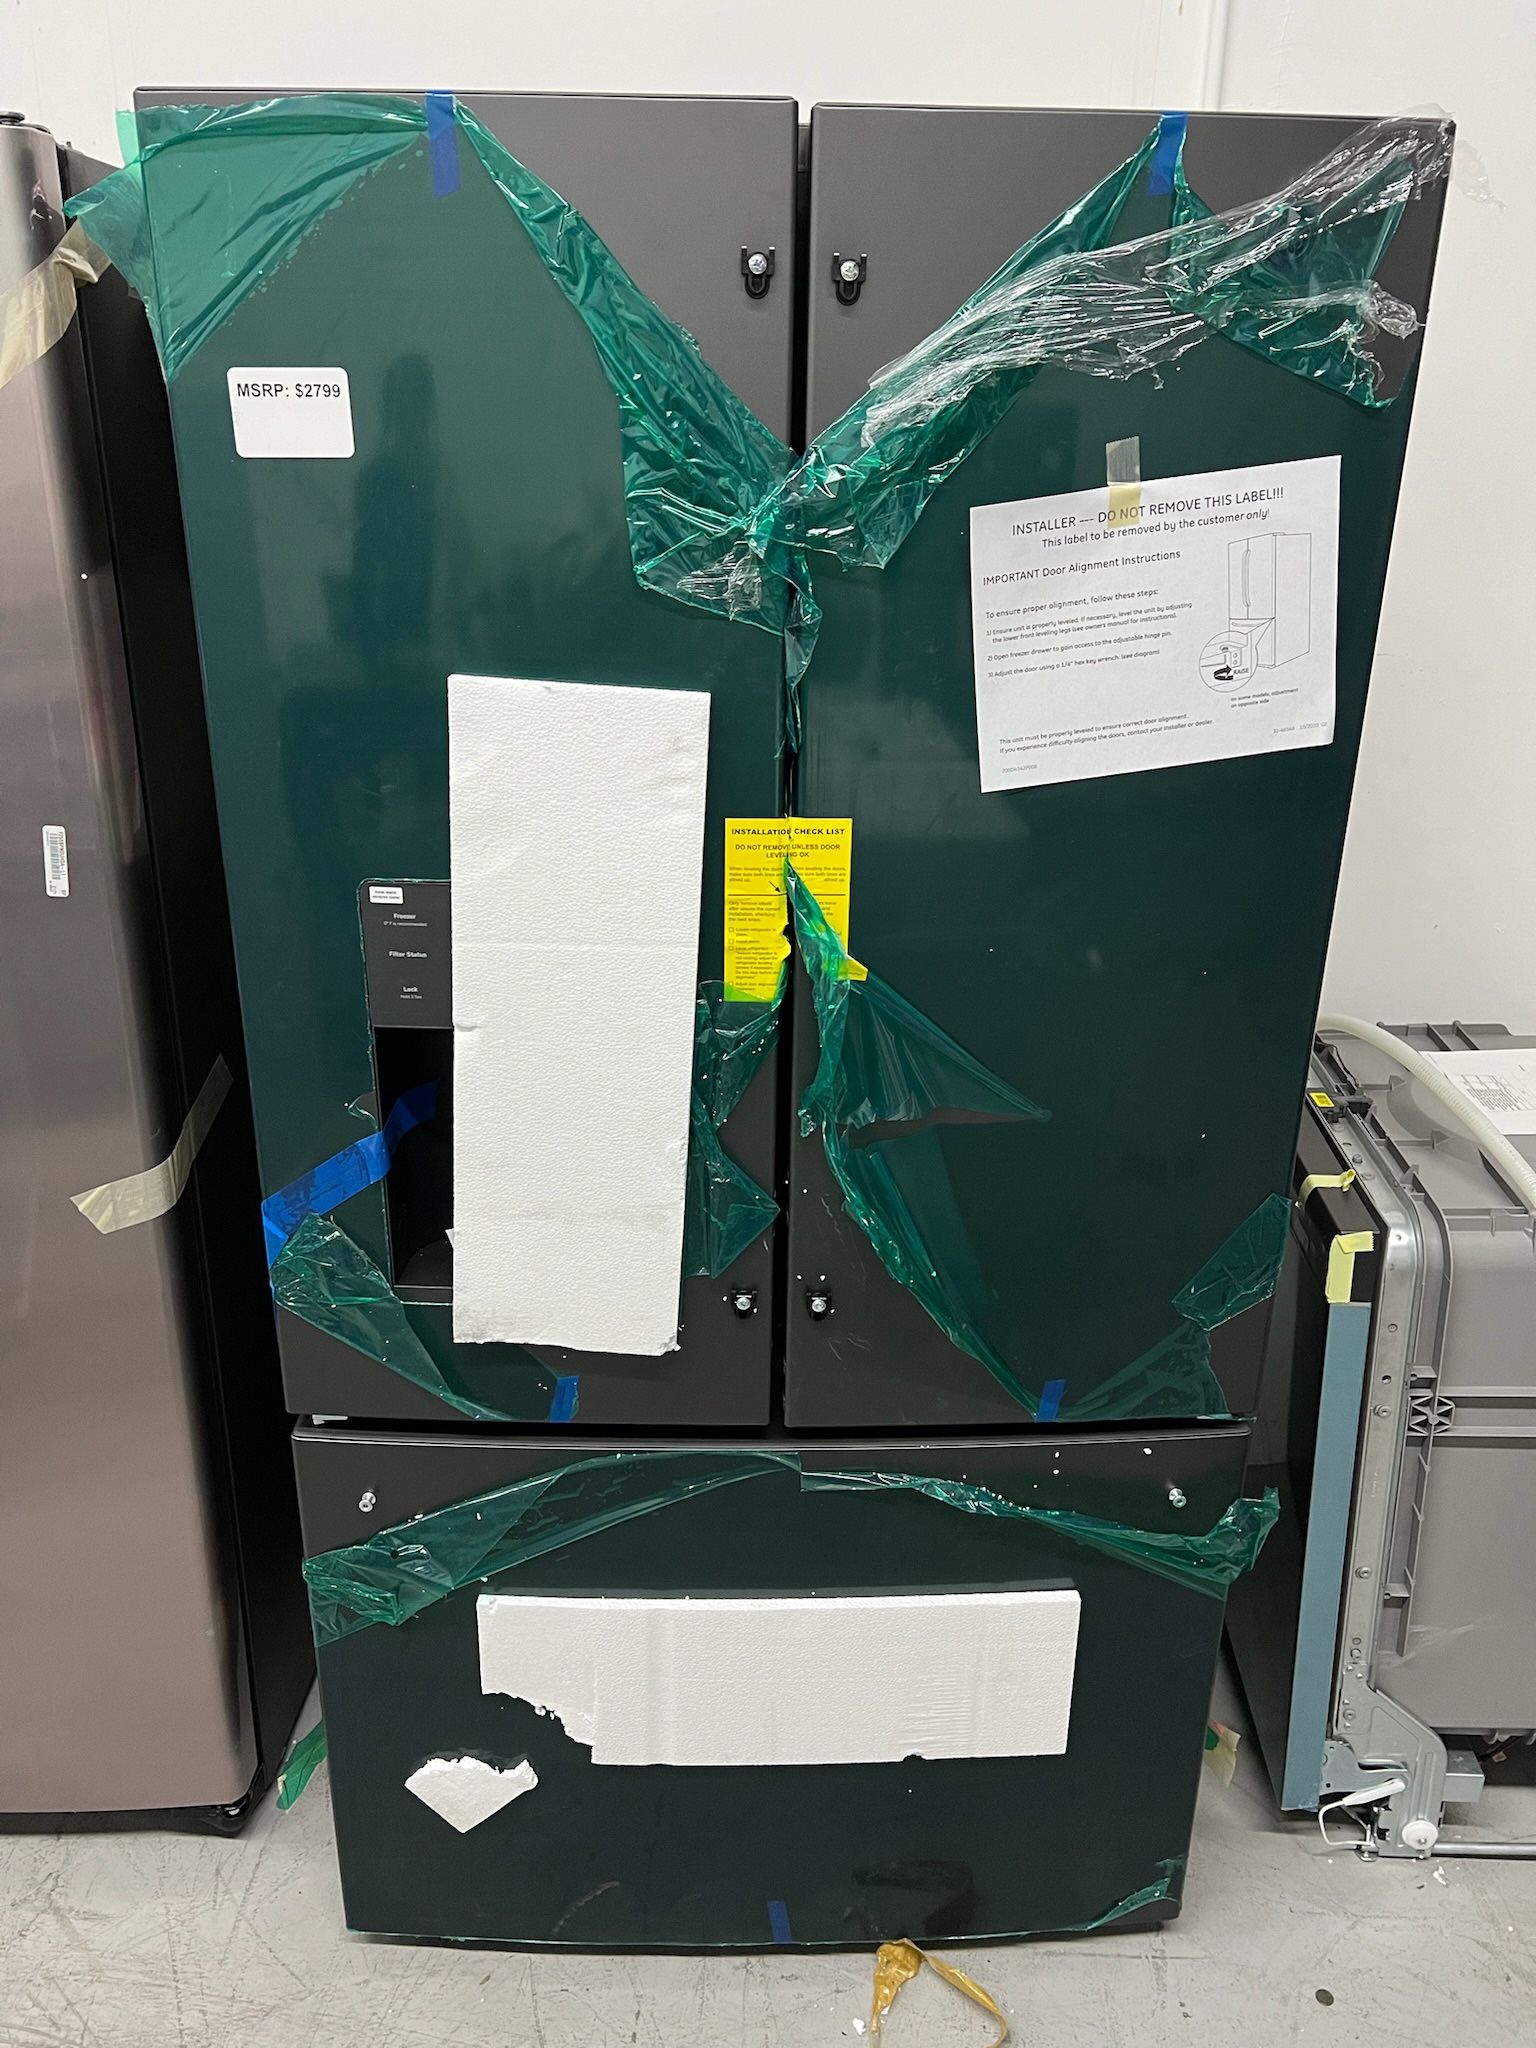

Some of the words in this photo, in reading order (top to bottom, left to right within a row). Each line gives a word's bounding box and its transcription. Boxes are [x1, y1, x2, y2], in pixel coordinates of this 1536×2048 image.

[237, 383, 289, 398] MSRP:
[295, 383, 341, 398] $2799
[1012, 516, 1076, 536] INSTALLER
[1098, 510, 1116, 523] DO
[1120, 505, 1146, 519] NOT
[1149, 498, 1201, 516] REMOVE
[1204, 494, 1232, 508] THIS
[1235, 487, 1284, 504] LABEL!!!
[1042, 538, 1062, 548] This
[1064, 532, 1088, 545] label
[1090, 532, 1101, 541] to
[1103, 529, 1115, 539] be
[1117, 522, 1161, 537] removed
[1163, 521, 1176, 532] by
[1179, 518, 1195, 529] the
[1197, 513, 1244, 527] customer
[983, 568, 1040, 586] IMPORTANT
[1042, 566, 1066, 577] Door
[1068, 558, 1119, 573] Alignment
[1121, 550, 1181, 566] Instructions
[985, 611, 995, 619] To
[996, 608, 1021, 617] ensure
[1022, 603, 1047, 614] proper
[1048, 597, 1089, 610] alignment,
[1090, 594, 1113, 603] follow
[1115, 592, 1135, 600] these
[1137, 589, 1159, 597] steps:
[393, 912, 417, 920] Freezer
[388, 950, 405, 958] Filter
